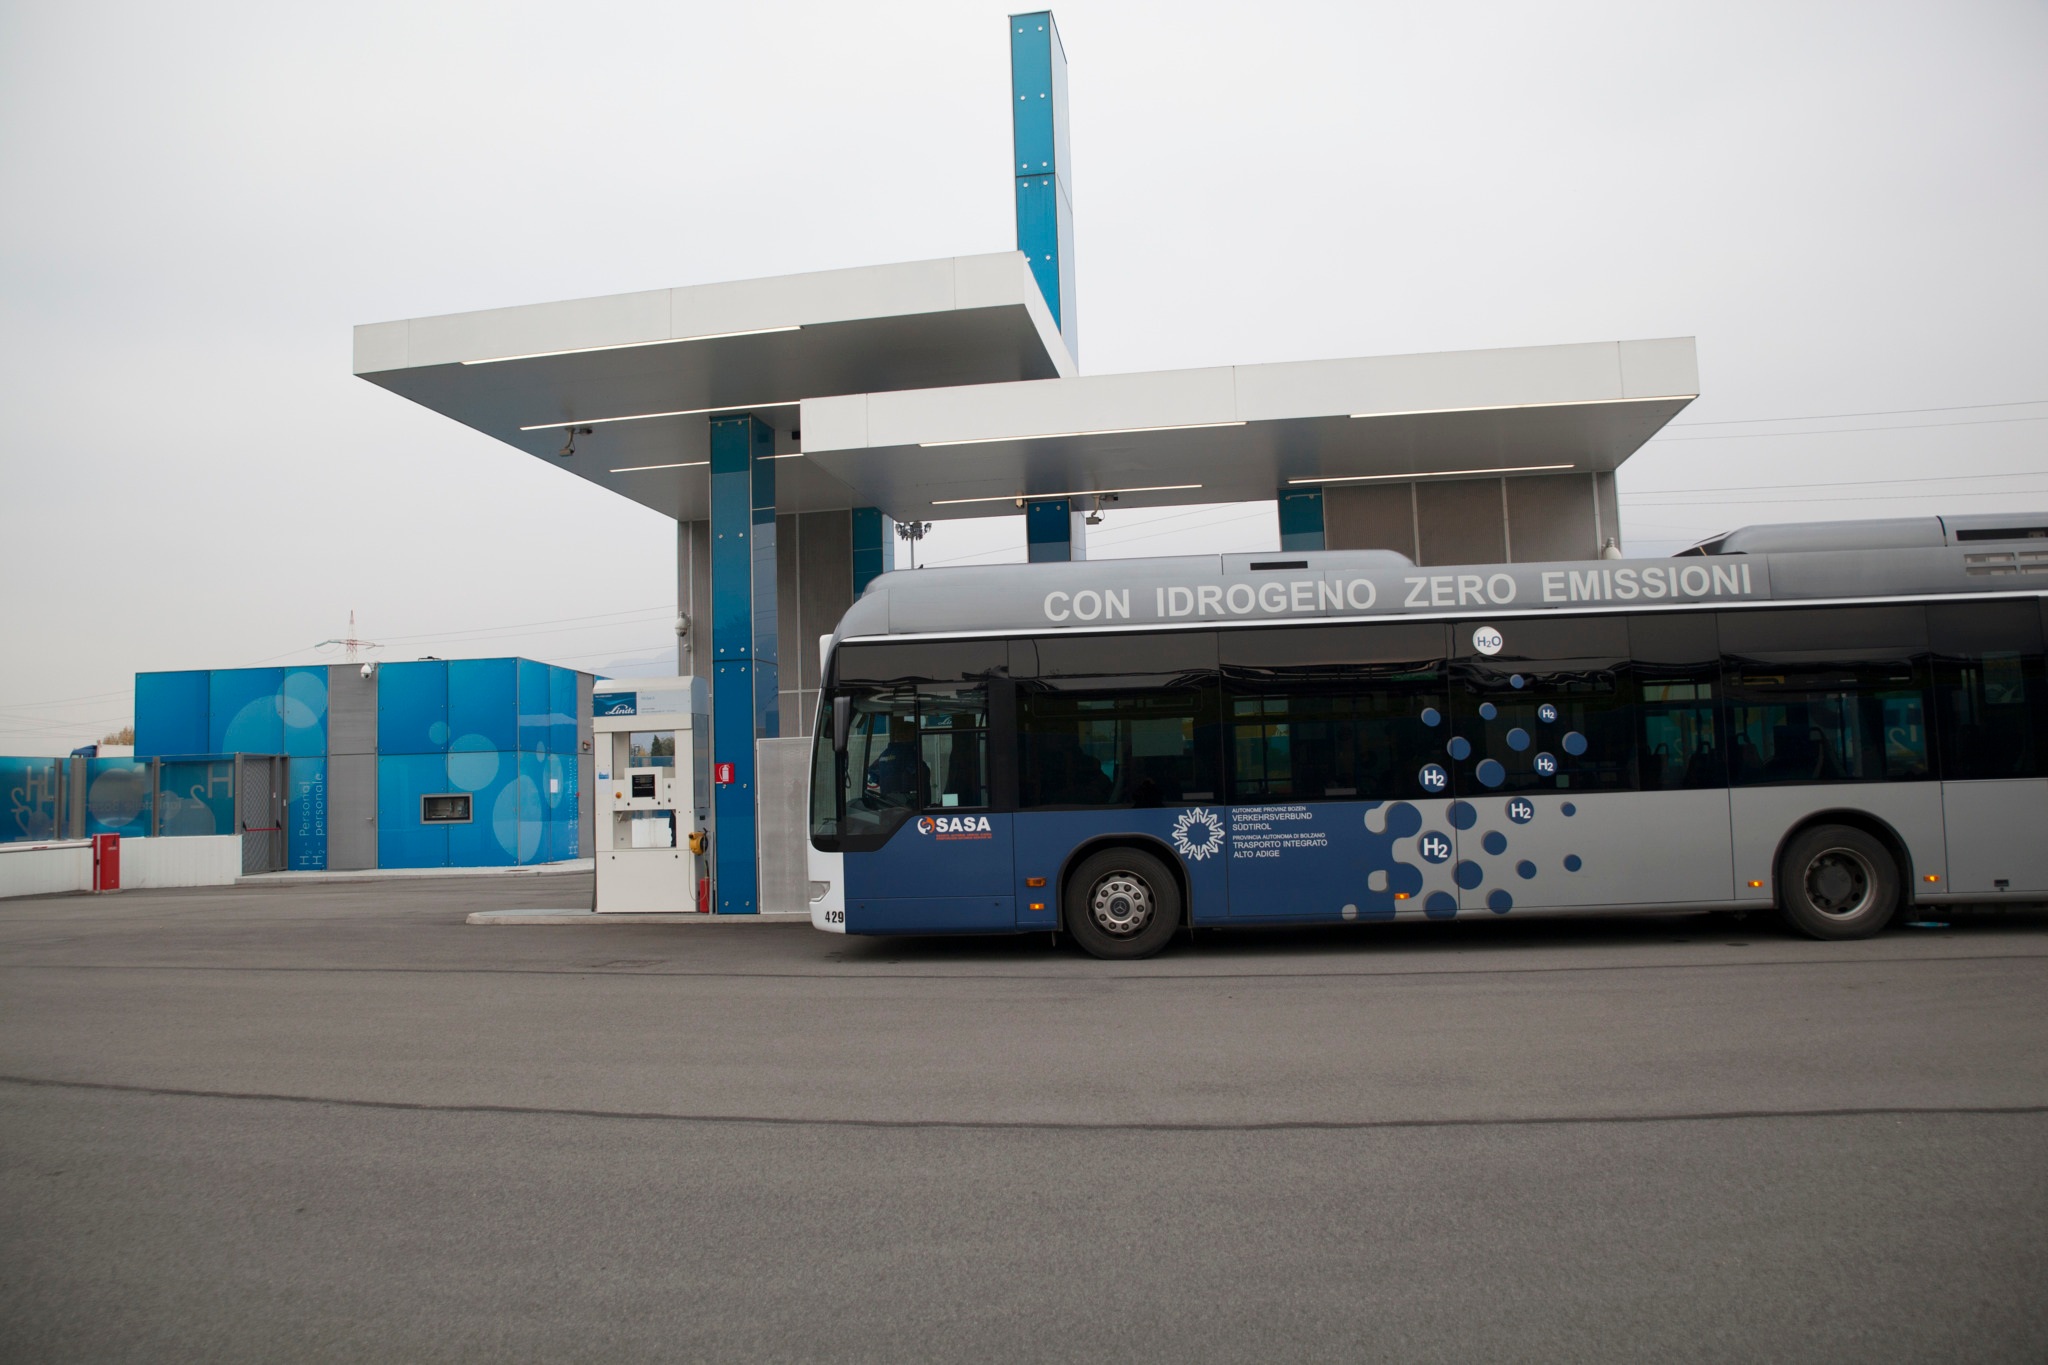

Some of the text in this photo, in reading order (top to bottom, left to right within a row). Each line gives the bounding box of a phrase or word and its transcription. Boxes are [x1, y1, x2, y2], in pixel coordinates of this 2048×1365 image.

[1044, 563, 1752, 621] CON IDROGENO ZERO EMISSIONI
[1477, 636, 1502, 648] H2O
[605, 704, 635, 715] Linde
[1542, 709, 1555, 719] H2
[1537, 758, 1554, 772] H2
[1424, 770, 1445, 787] H2
[299, 781, 310, 836] Personal
[312, 773, 326, 836] personale
[1511, 803, 1531, 819] H2
[1232, 812, 1312, 821] VERKEHRSVERBUND
[936, 816, 991, 832] SASA
[1232, 822, 1272, 831] SÜDTIROL
[1233, 839, 1328, 849] TRASPORTO INTEGRATO
[1423, 838, 1448, 859] H2
[1233, 850, 1253, 858] ALTO
[825, 911, 844, 923] 429
